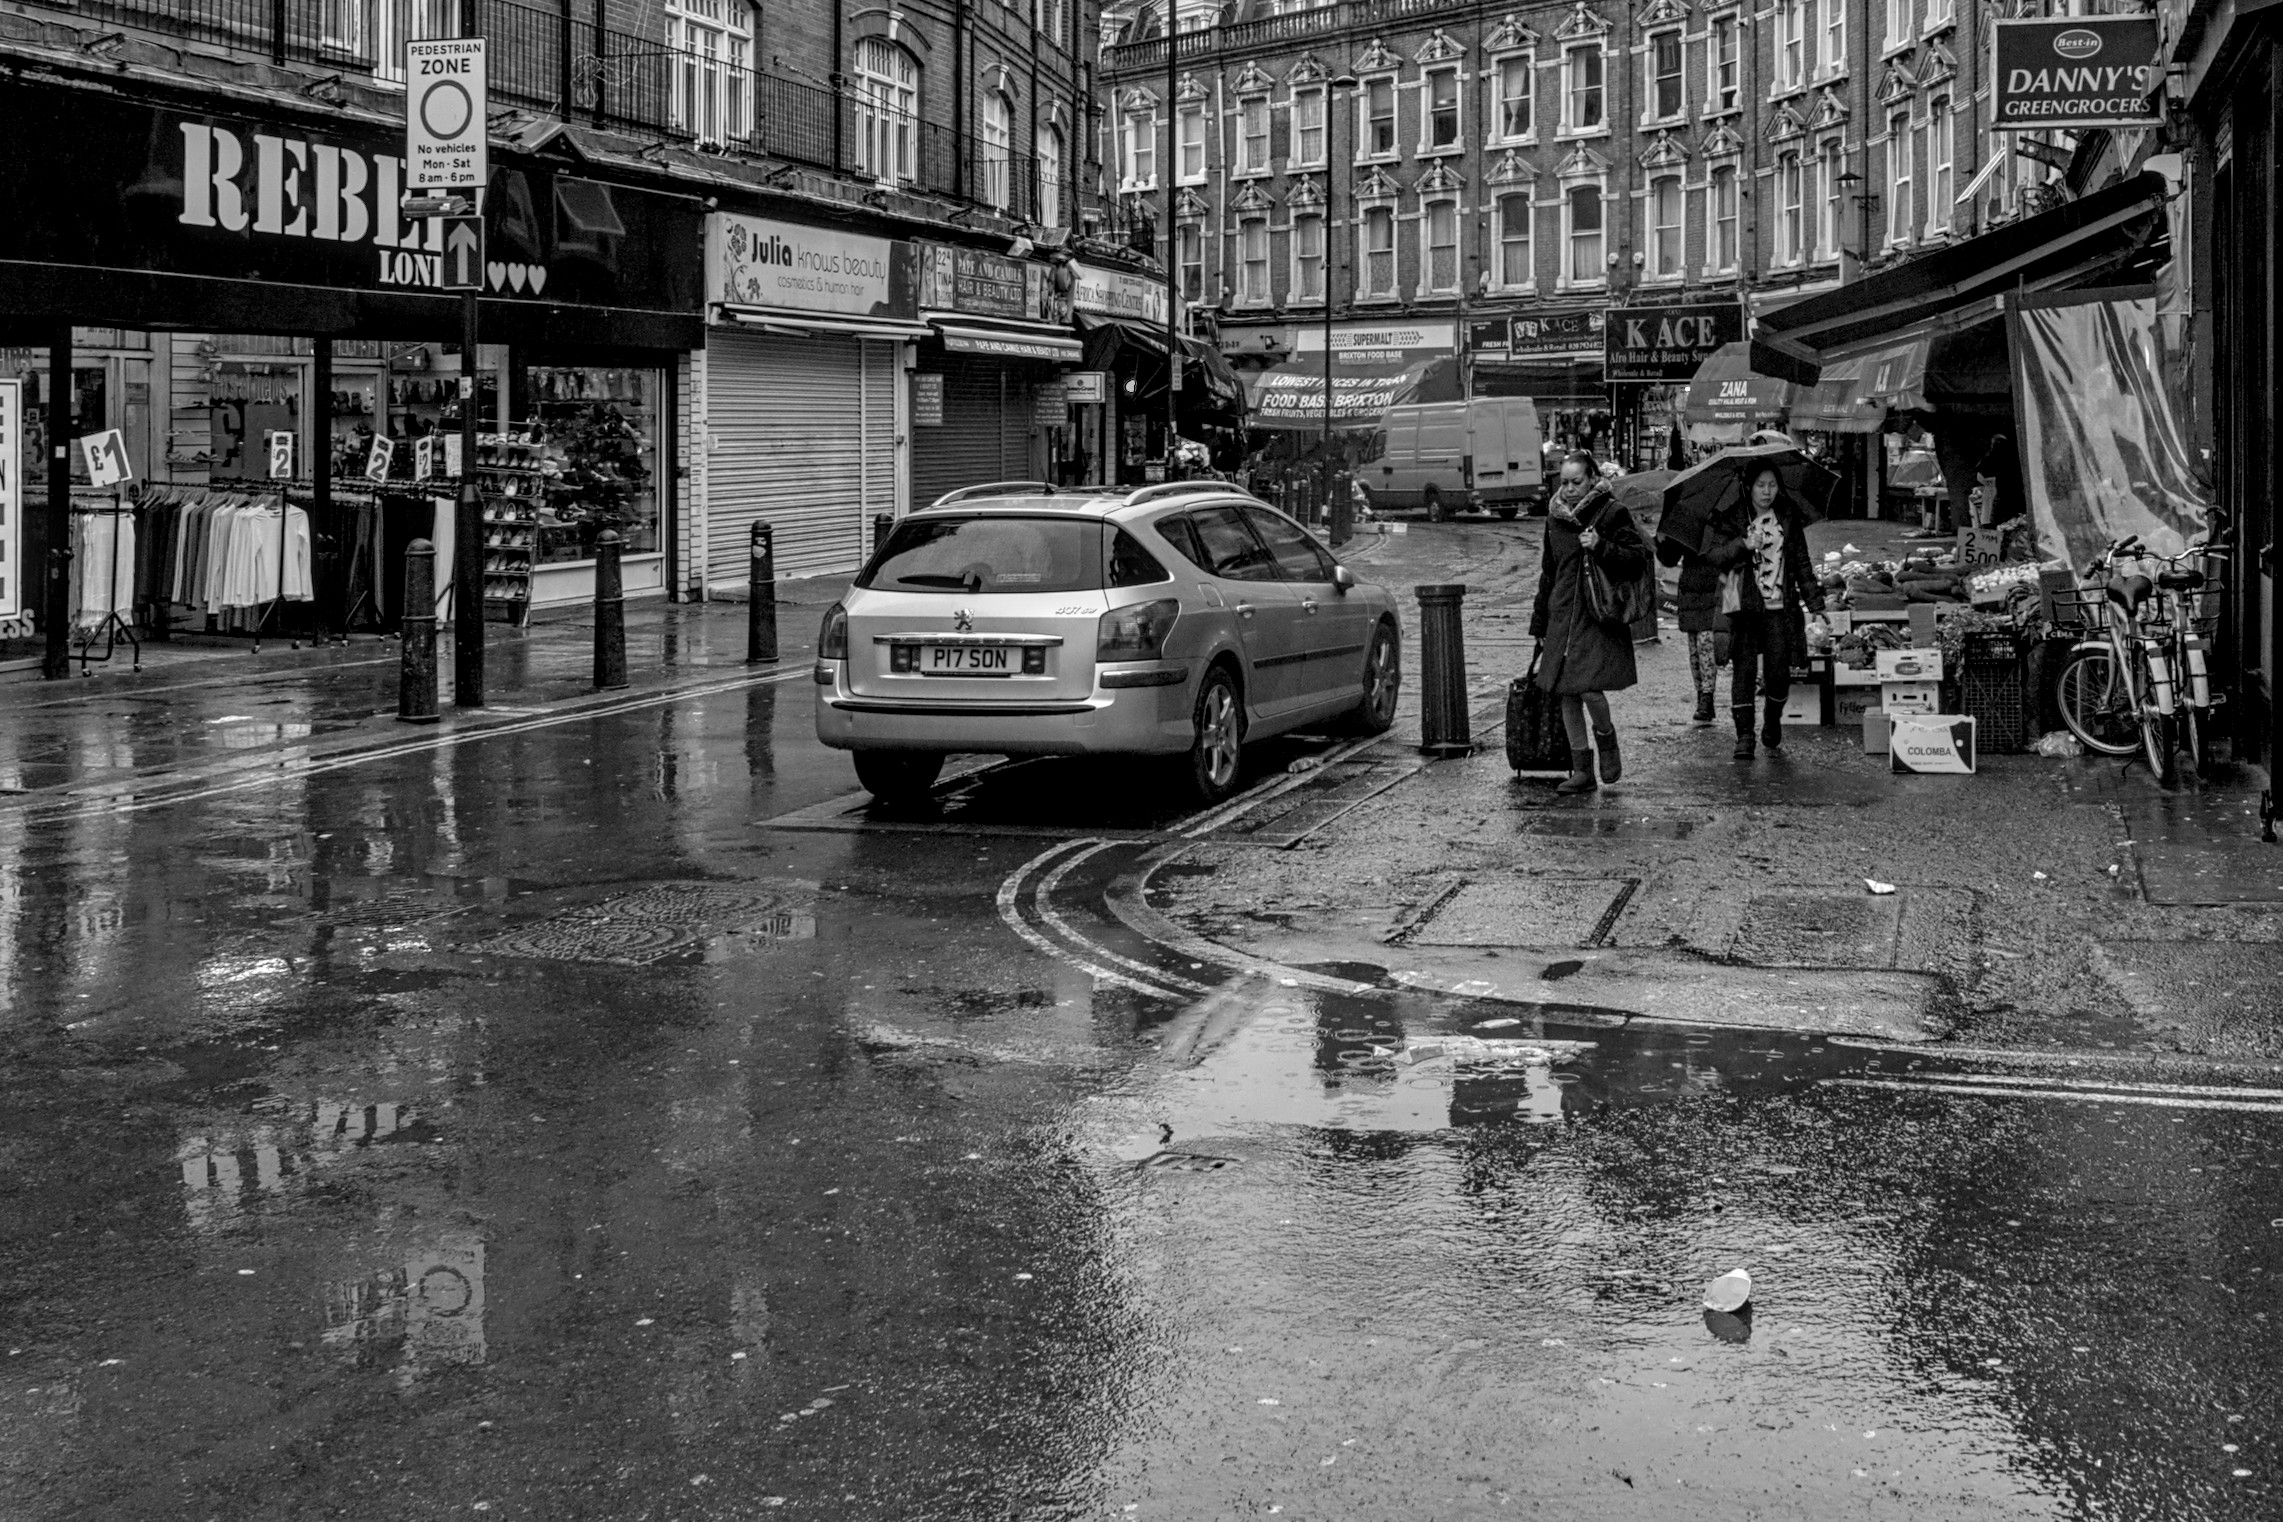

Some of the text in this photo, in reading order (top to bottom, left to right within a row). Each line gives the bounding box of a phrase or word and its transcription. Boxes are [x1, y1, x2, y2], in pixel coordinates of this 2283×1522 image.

[411, 43, 482, 56] PEDESTRIAN
[420, 58, 472, 75] ZONE
[2005, 98, 2151, 116] GREENGROCERS
[417, 143, 477, 154] No vehicles
[423, 159, 445, 169] Mon
[452, 158, 471, 169] Sat
[752, 233, 887, 285] Julia knows beauty
[777, 276, 815, 291] cosmetics
[1625, 316, 1717, 349] K ACE
[1353, 333, 1393, 346] SUPERMALT
[1338, 349, 1403, 360] BRIXTON FOOD BASE
[1628, 351, 1649, 363] Hair
[1271, 375, 1319, 387] LOWEST
[1719, 380, 1748, 398] ZANA
[1262, 391, 1395, 408] FOOD BAS BRIXTON
[1260, 408, 1280, 417] FRESH
[1965, 532, 1976, 548] 2
[1055, 607, 1081, 615] 407
[934, 649, 1007, 669] P17 SON
[1907, 746, 1952, 757] COLOMBA
